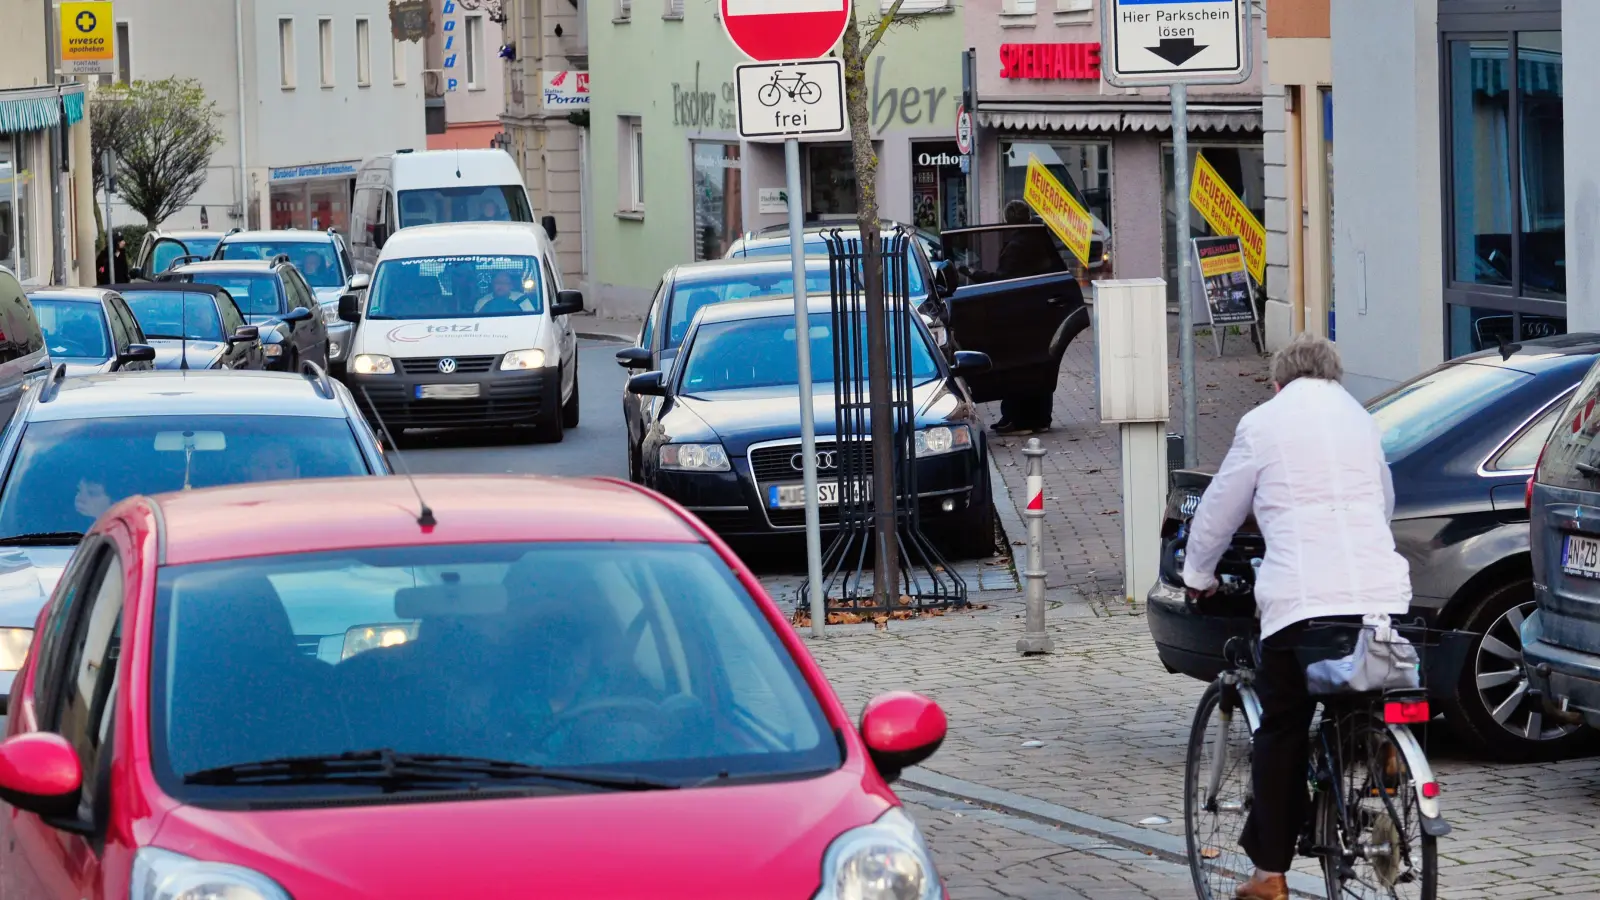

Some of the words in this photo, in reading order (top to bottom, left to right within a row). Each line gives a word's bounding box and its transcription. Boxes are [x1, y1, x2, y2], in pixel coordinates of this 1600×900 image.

[1123, 11, 1151, 23] Hier
[1156, 8, 1230, 22] Parkschein
[69, 37, 104, 45] vivesco
[1158, 26, 1195, 37] lösen
[69, 46, 105, 54] apotheken
[1000, 42, 1101, 79] SPIELHALLE
[671, 60, 716, 134] Fischer
[872, 55, 947, 136] her
[775, 110, 807, 127] frei
[1031, 166, 1088, 240] NEUERÖFFNUNG
[1196, 190, 1210, 211] nach
[1198, 167, 1263, 255] NEUERÖFFNUNG
[426, 322, 480, 333] tetzl
[1568, 539, 1580, 564] AN
[1584, 541, 1598, 568] ZB
